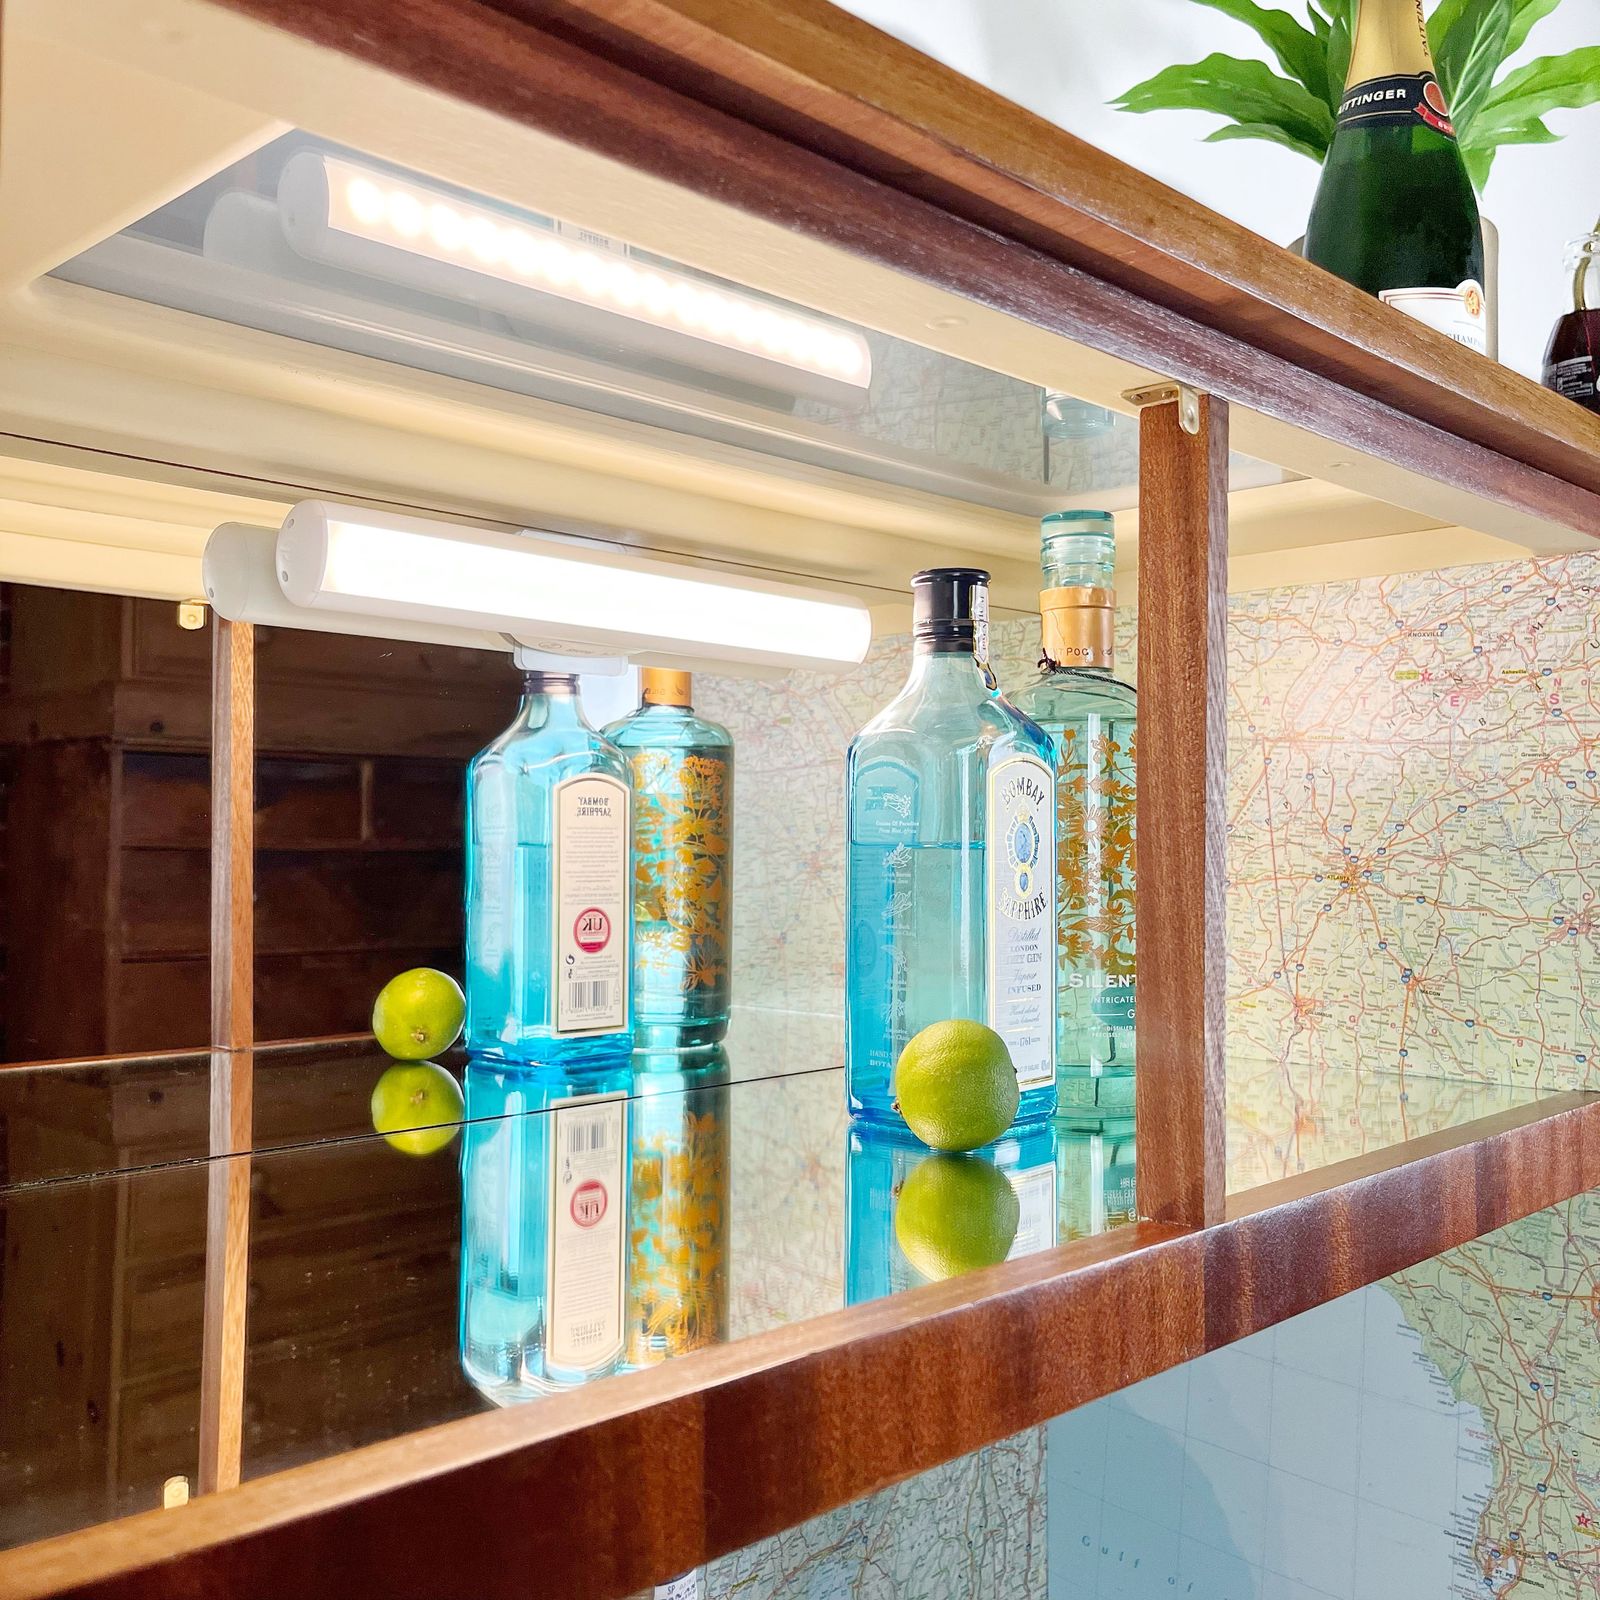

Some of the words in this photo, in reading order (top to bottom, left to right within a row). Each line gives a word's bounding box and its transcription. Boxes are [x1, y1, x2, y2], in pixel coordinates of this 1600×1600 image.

[1002, 776, 1045, 805] BOMBAY
[1010, 944, 1039, 952] LONDON
[1026, 953, 1042, 963] GIN
[1007, 984, 1042, 994] INFUSED
[1419, 989, 1441, 997] MACON
[1305, 1009, 1333, 1019] COLUMBUS
[1081, 1535, 1140, 1569] Gulf
[1167, 1575, 1194, 1593] of
